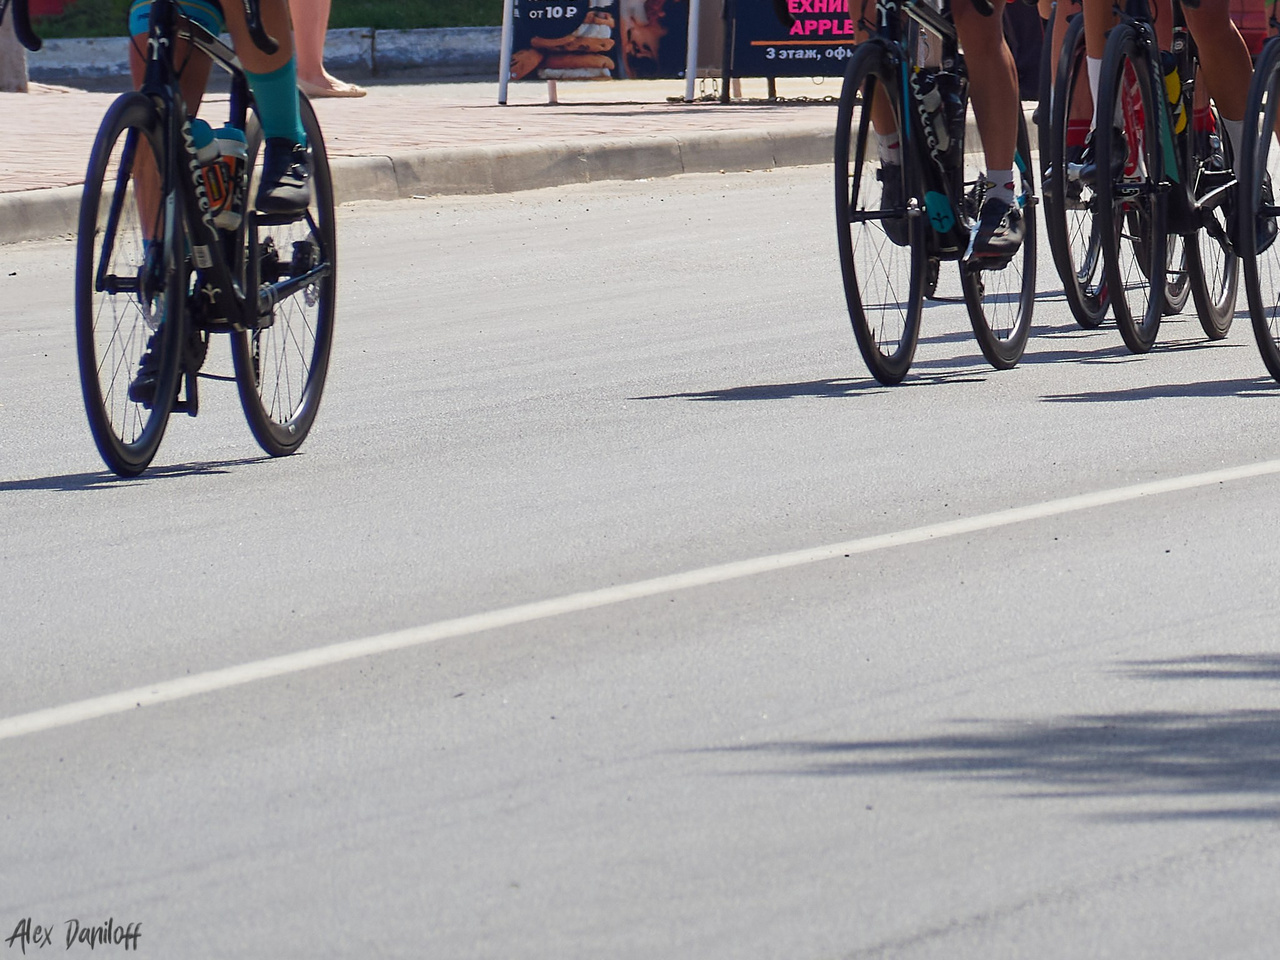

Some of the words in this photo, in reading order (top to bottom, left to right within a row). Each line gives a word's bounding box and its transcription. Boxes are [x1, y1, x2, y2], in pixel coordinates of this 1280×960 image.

[545, 6, 563, 19] 10
[565, 6, 577, 18] ₽
[789, 19, 855, 36] APPLE
[765, 48, 776, 59] 3
[778, 49, 821, 60] этаж,
